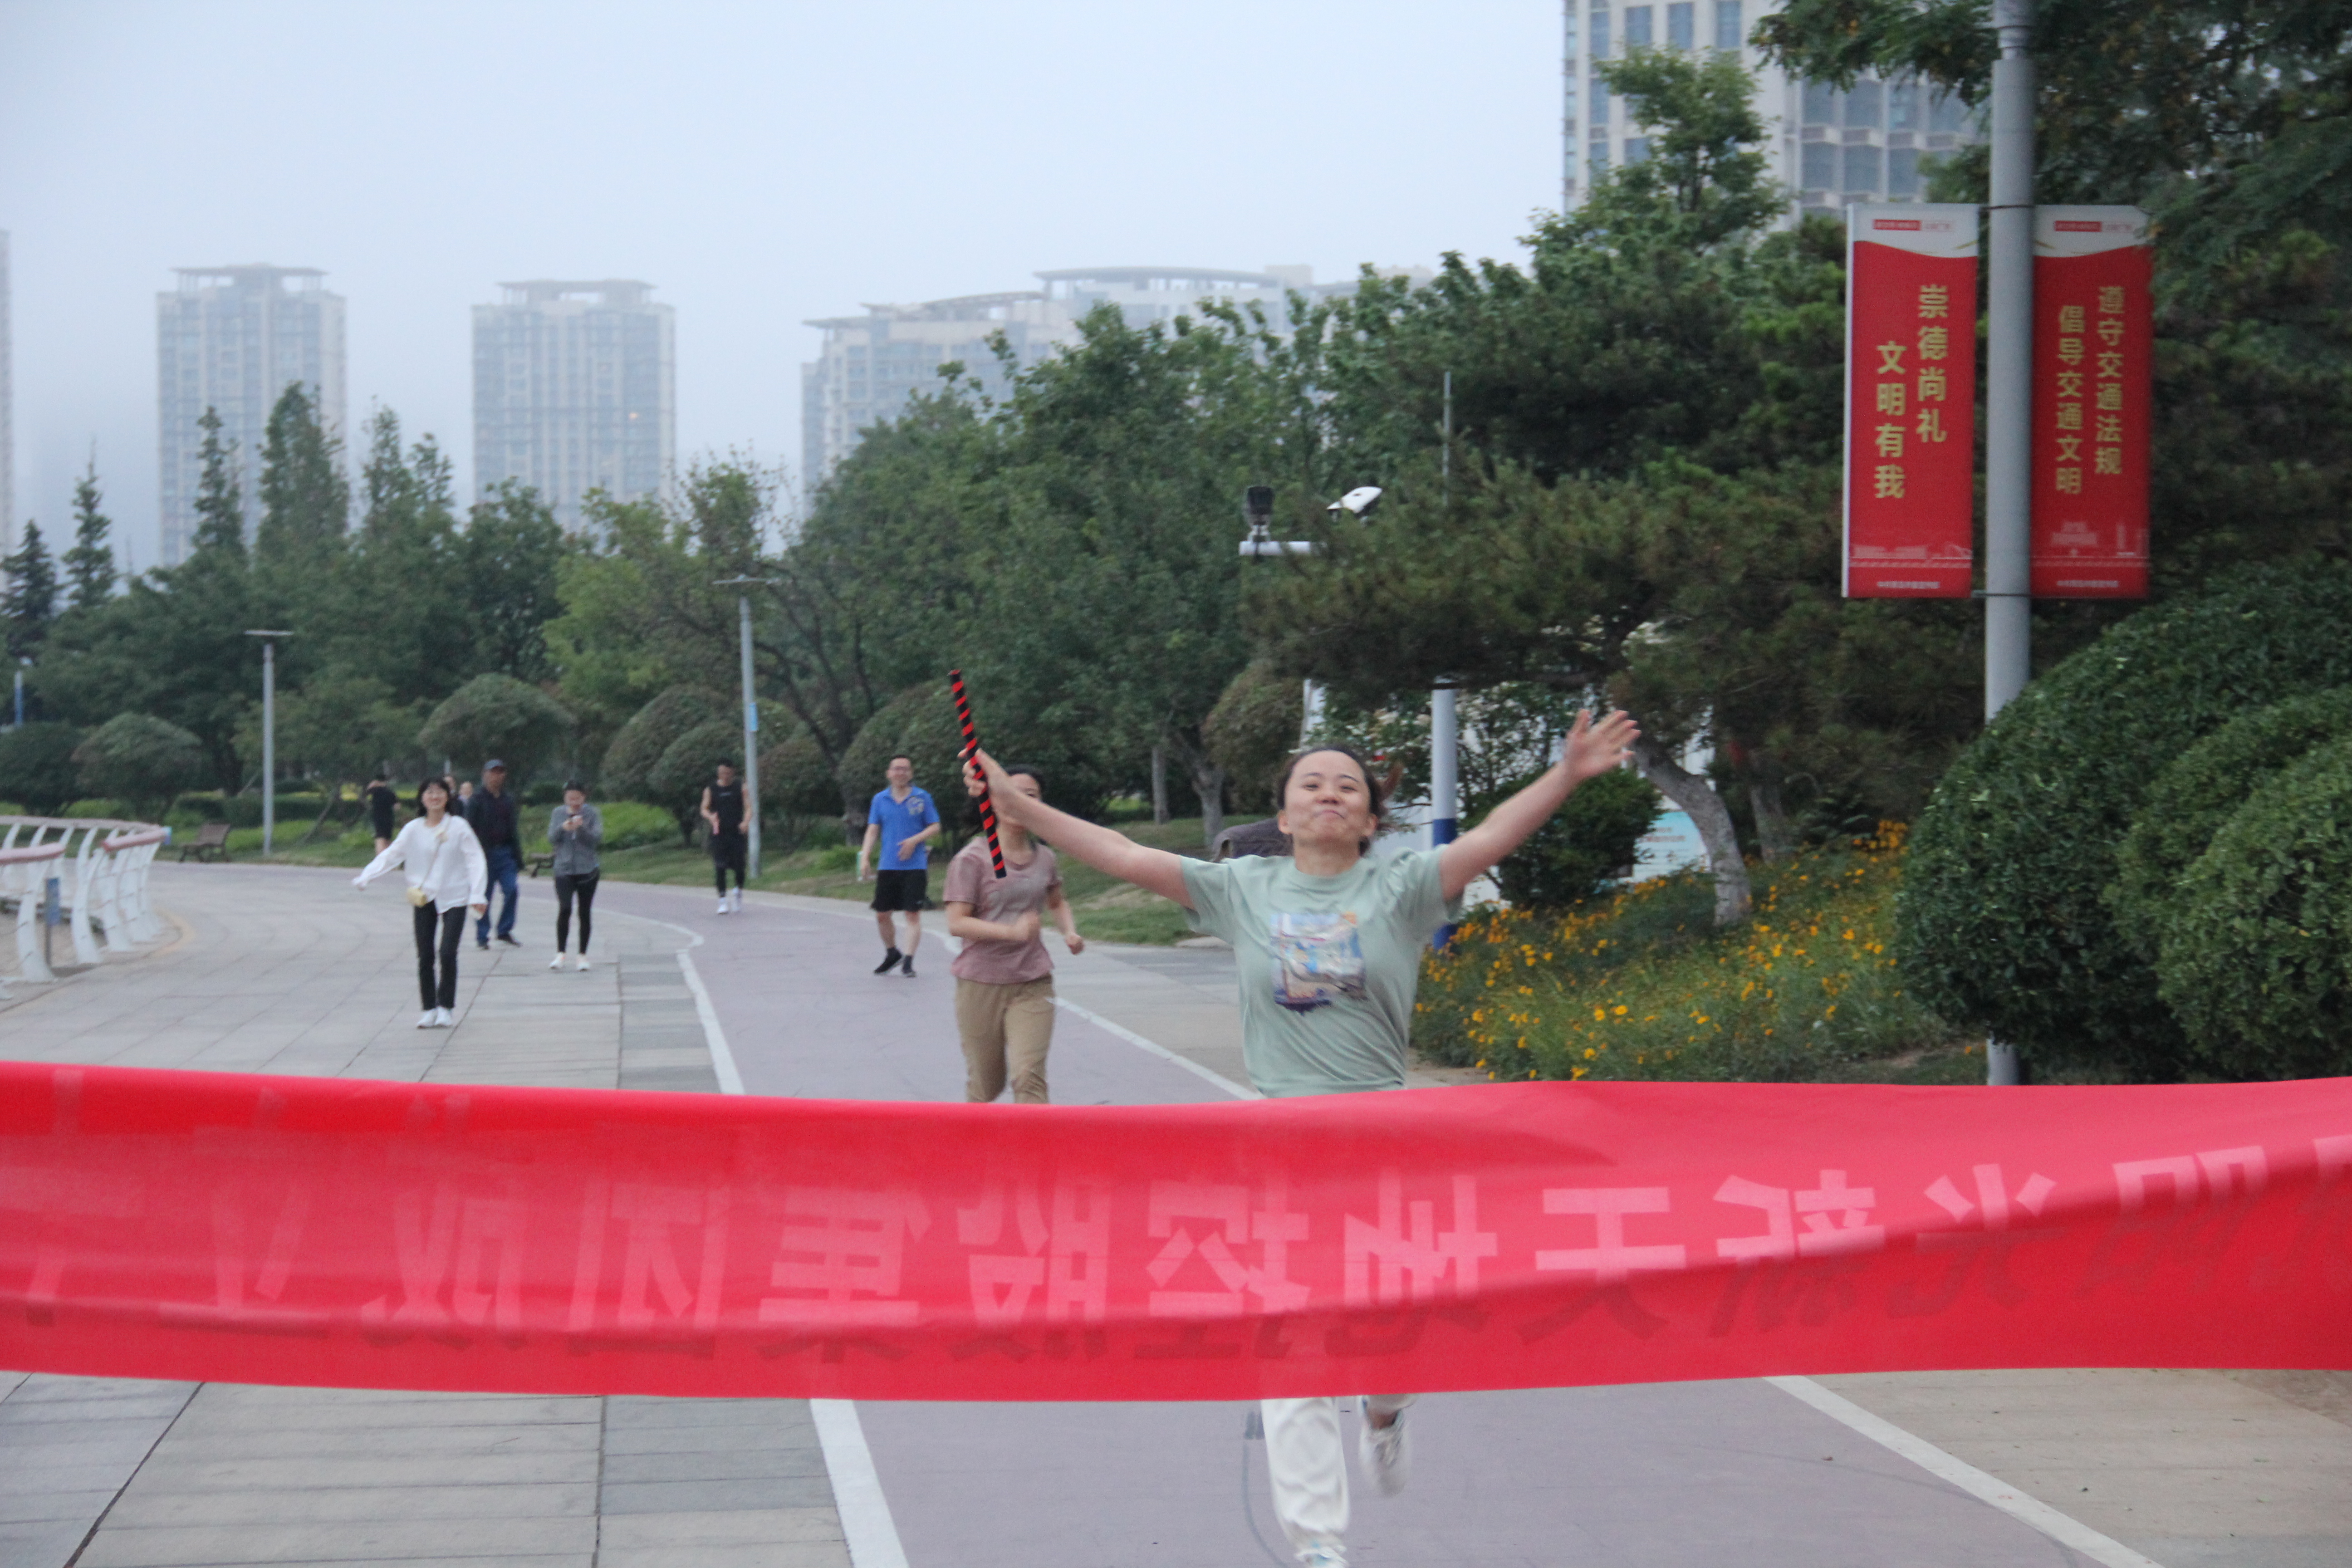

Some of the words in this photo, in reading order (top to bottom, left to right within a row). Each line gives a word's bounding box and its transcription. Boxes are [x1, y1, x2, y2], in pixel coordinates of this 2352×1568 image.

[1874, 340, 1906, 499] 文明有我
[1916, 284, 1949, 443] 崇德尚礼
[2056, 305, 2085, 495] 倡导交通文明
[2095, 286, 2125, 474] 遵守交通法规
